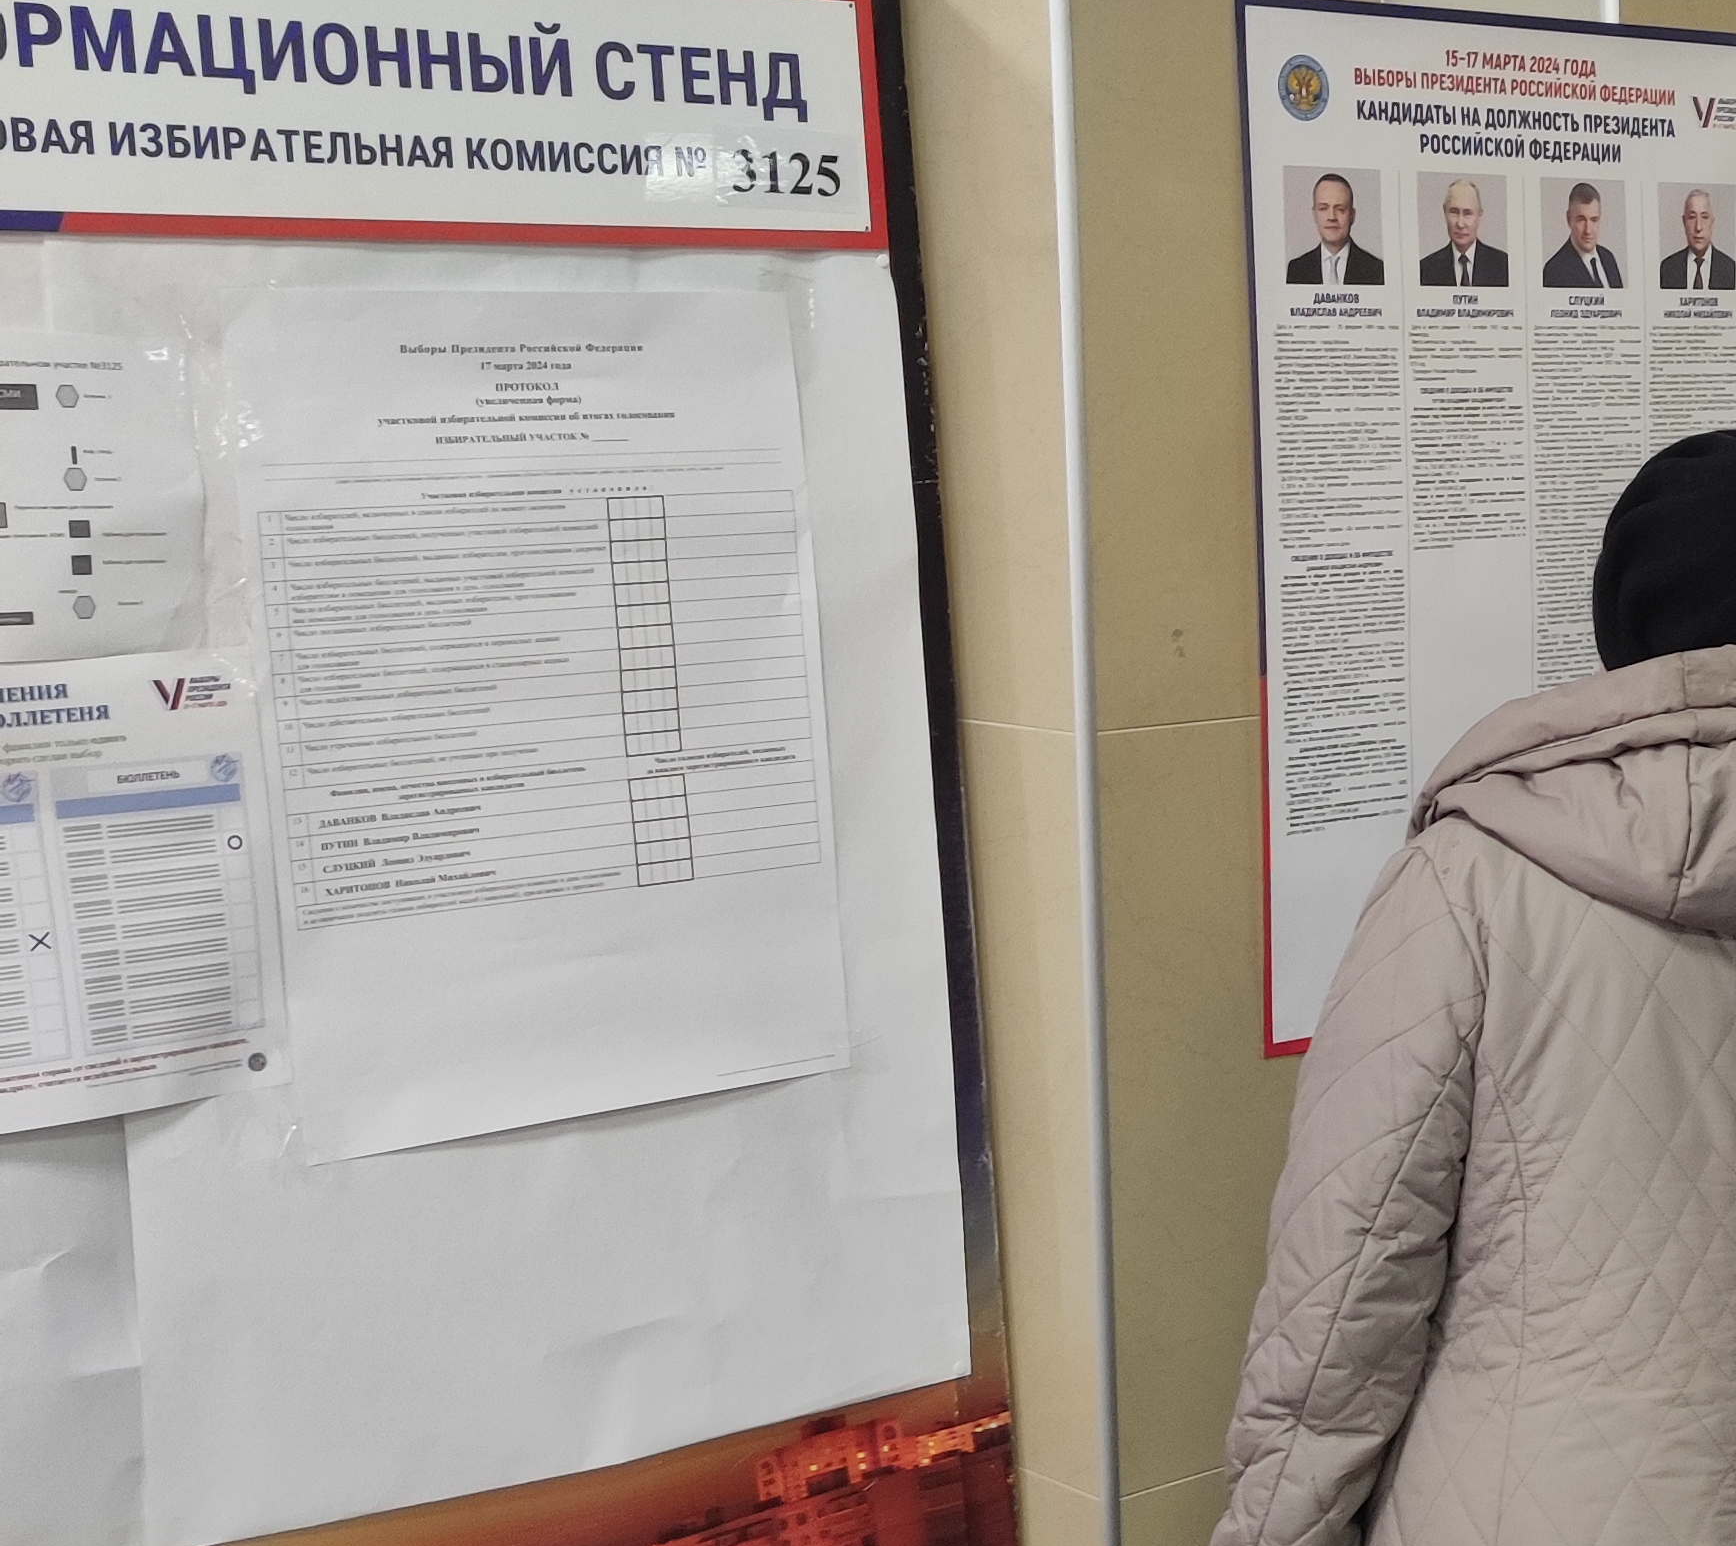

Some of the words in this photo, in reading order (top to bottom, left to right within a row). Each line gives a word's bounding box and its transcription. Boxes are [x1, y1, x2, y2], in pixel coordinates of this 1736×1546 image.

[0, 0, 573, 97] РМАЦИОННЫЙ
[596, 41, 808, 122] СТЕНД
[1445, 49, 1479, 67] 15-17
[1482, 54, 1526, 72] МАРТА
[1530, 55, 1560, 74] 2024
[1564, 58, 1597, 78] ГОДА
[1354, 67, 1417, 89] ВЫБОРЫ
[1421, 72, 1507, 96] ПРЕЗИДЕНТА
[1511, 78, 1597, 102] РОССИЙСКОЙ
[1600, 84, 1676, 108] ФЕДЕРАЦИИ
[1357, 100, 1457, 126] КАНДИДАТЫ
[1461, 107, 1480, 127] НА
[1485, 108, 1580, 133] ДОЛЖНОСТЬ
[1583, 114, 1676, 138] ПРЕЗИДЕНТА
[0, 117, 96, 155] ВАЯ
[109, 121, 454, 169] ИЗБИРАТЕЛЬНАЯ
[466, 136, 664, 177] КОМИССИЯ
[732, 148, 841, 197] 3125
[1420, 131, 1525, 157] РОССИЙСКОЙ
[1529, 138, 1622, 164] ФЕДЕРАЦИИ
[400, 344, 447, 356] Выборы
[526, 360, 548, 370] 2024
[495, 382, 559, 392] ПРОТОКОЛ
[0, 683, 69, 703] ЕНИЯ
